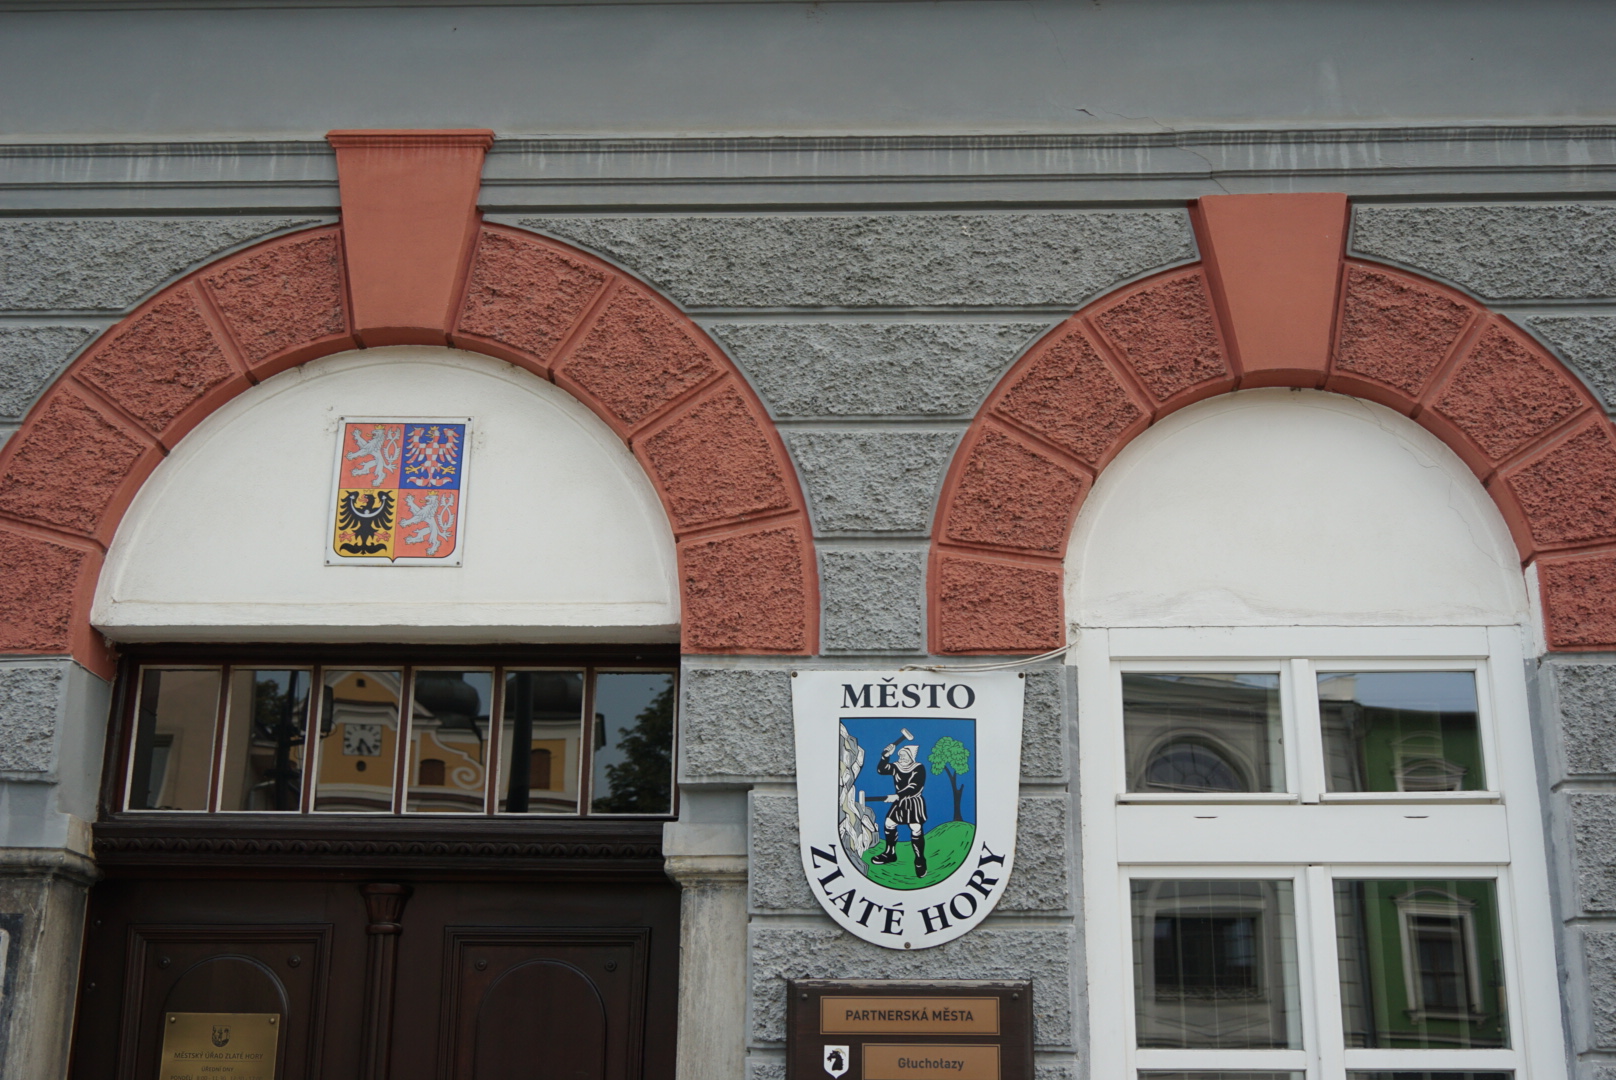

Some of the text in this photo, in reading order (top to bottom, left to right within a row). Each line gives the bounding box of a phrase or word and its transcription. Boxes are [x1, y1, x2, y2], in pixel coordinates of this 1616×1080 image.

[840, 677, 976, 709] MĚSTO
[810, 841, 1006, 936] ZLATÉ HORY
[845, 1007, 974, 1022] PARTNERSKÁ MĚSTA
